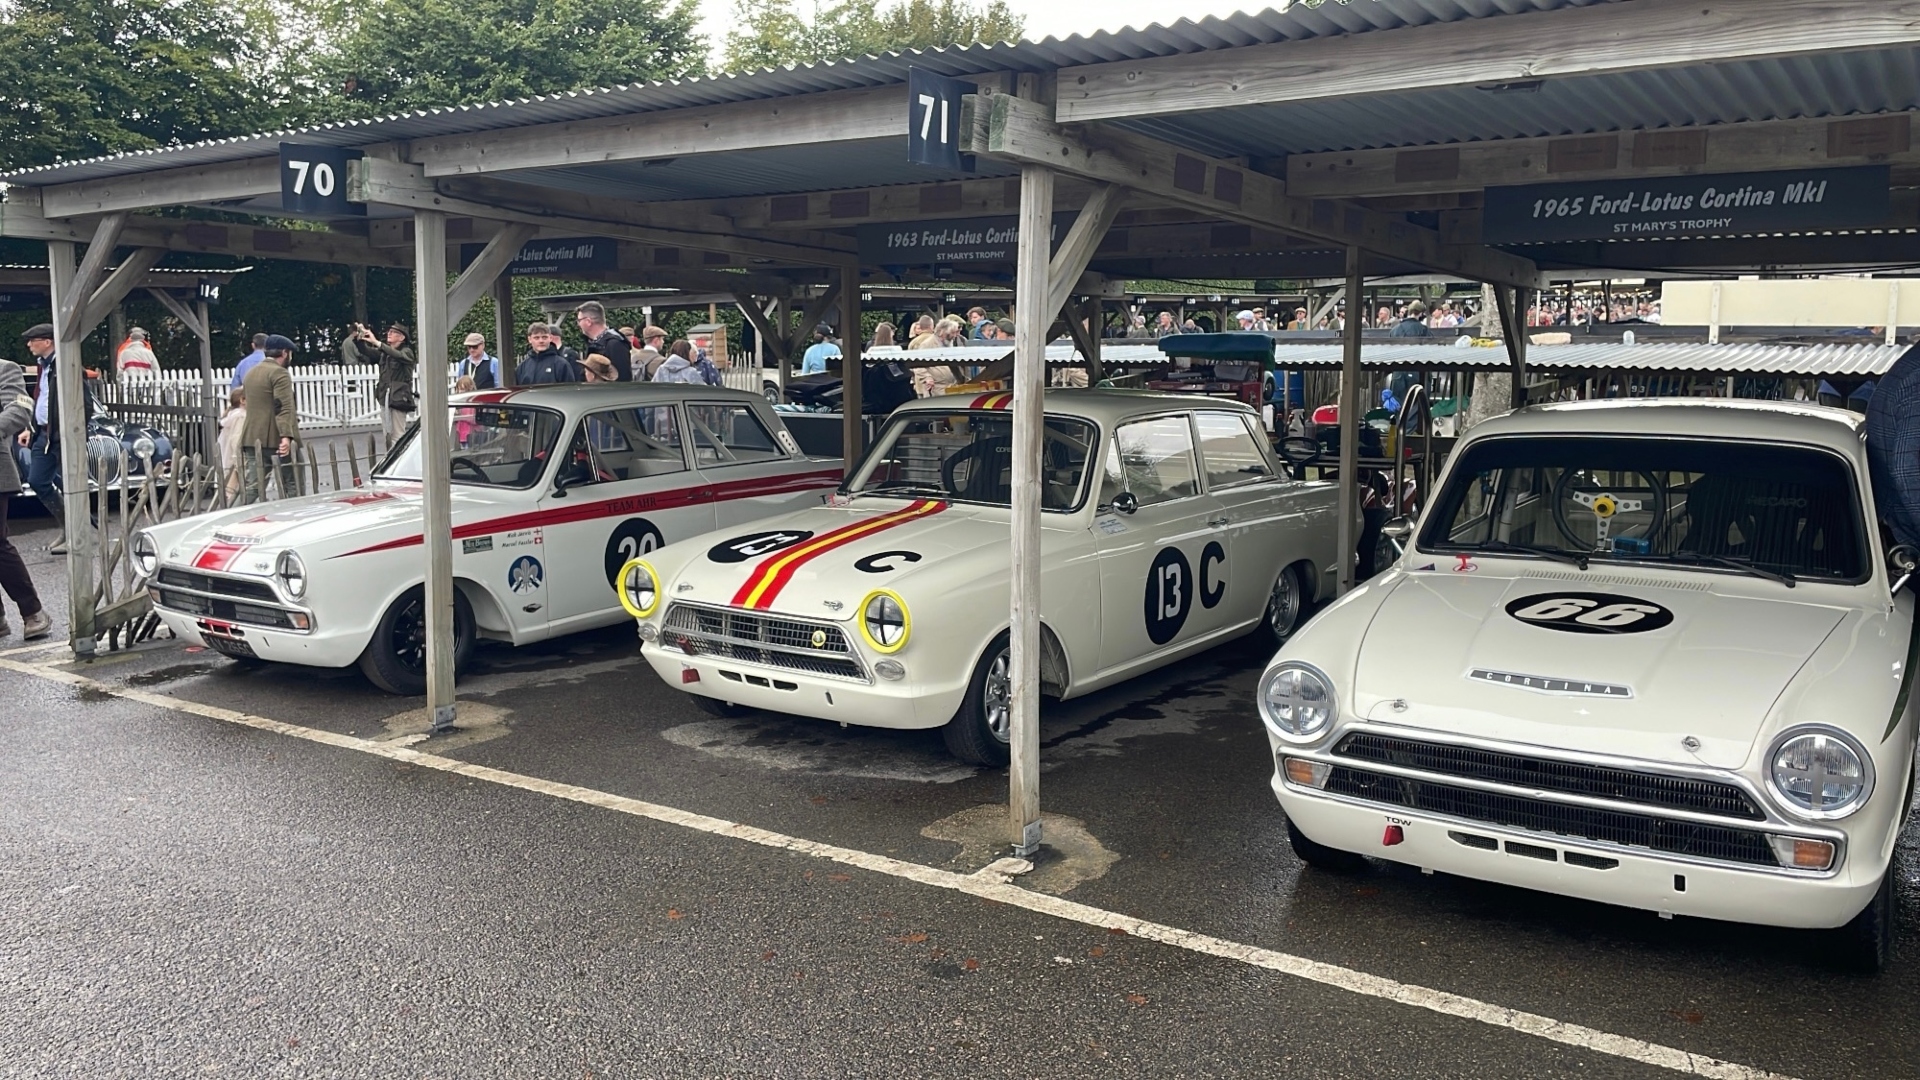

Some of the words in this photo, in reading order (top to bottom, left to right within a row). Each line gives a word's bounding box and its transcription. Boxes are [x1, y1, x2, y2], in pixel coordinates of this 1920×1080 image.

[918, 93, 948, 144] 71
[288, 160, 335, 197] 70
[1532, 196, 1585, 218] 1965
[1589, 191, 1694, 215] Ford-Lotus
[1699, 186, 1775, 209] Cortina
[1782, 180, 1828, 204] MkI
[1613, 223, 1629, 233] ST
[1631, 220, 1677, 232] MARY'S
[1680, 217, 1732, 230] TROPHY
[887, 232, 918, 248] 1963
[921, 228, 982, 247] Ford-Lotus
[545, 246, 574, 260] Cortina
[936, 252, 946, 261] ST
[947, 251, 974, 260] MARY'S
[975, 250, 1006, 260] TROPHY
[538, 265, 558, 273] TROPHY
[201, 284, 220, 299] 114
[862, 293, 872, 301] 115
[606, 500, 634, 513] TEAM
[636, 496, 657, 508] AHR
[616, 532, 658, 573] 20
[730, 532, 799, 555] 13
[854, 551, 922, 573] C
[1157, 563, 1181, 621] 13
[1199, 540, 1226, 609] C
[1514, 598, 1660, 626] 66
[1486, 672, 1612, 694] CORTINA
[1384, 816, 1411, 826] TOW
